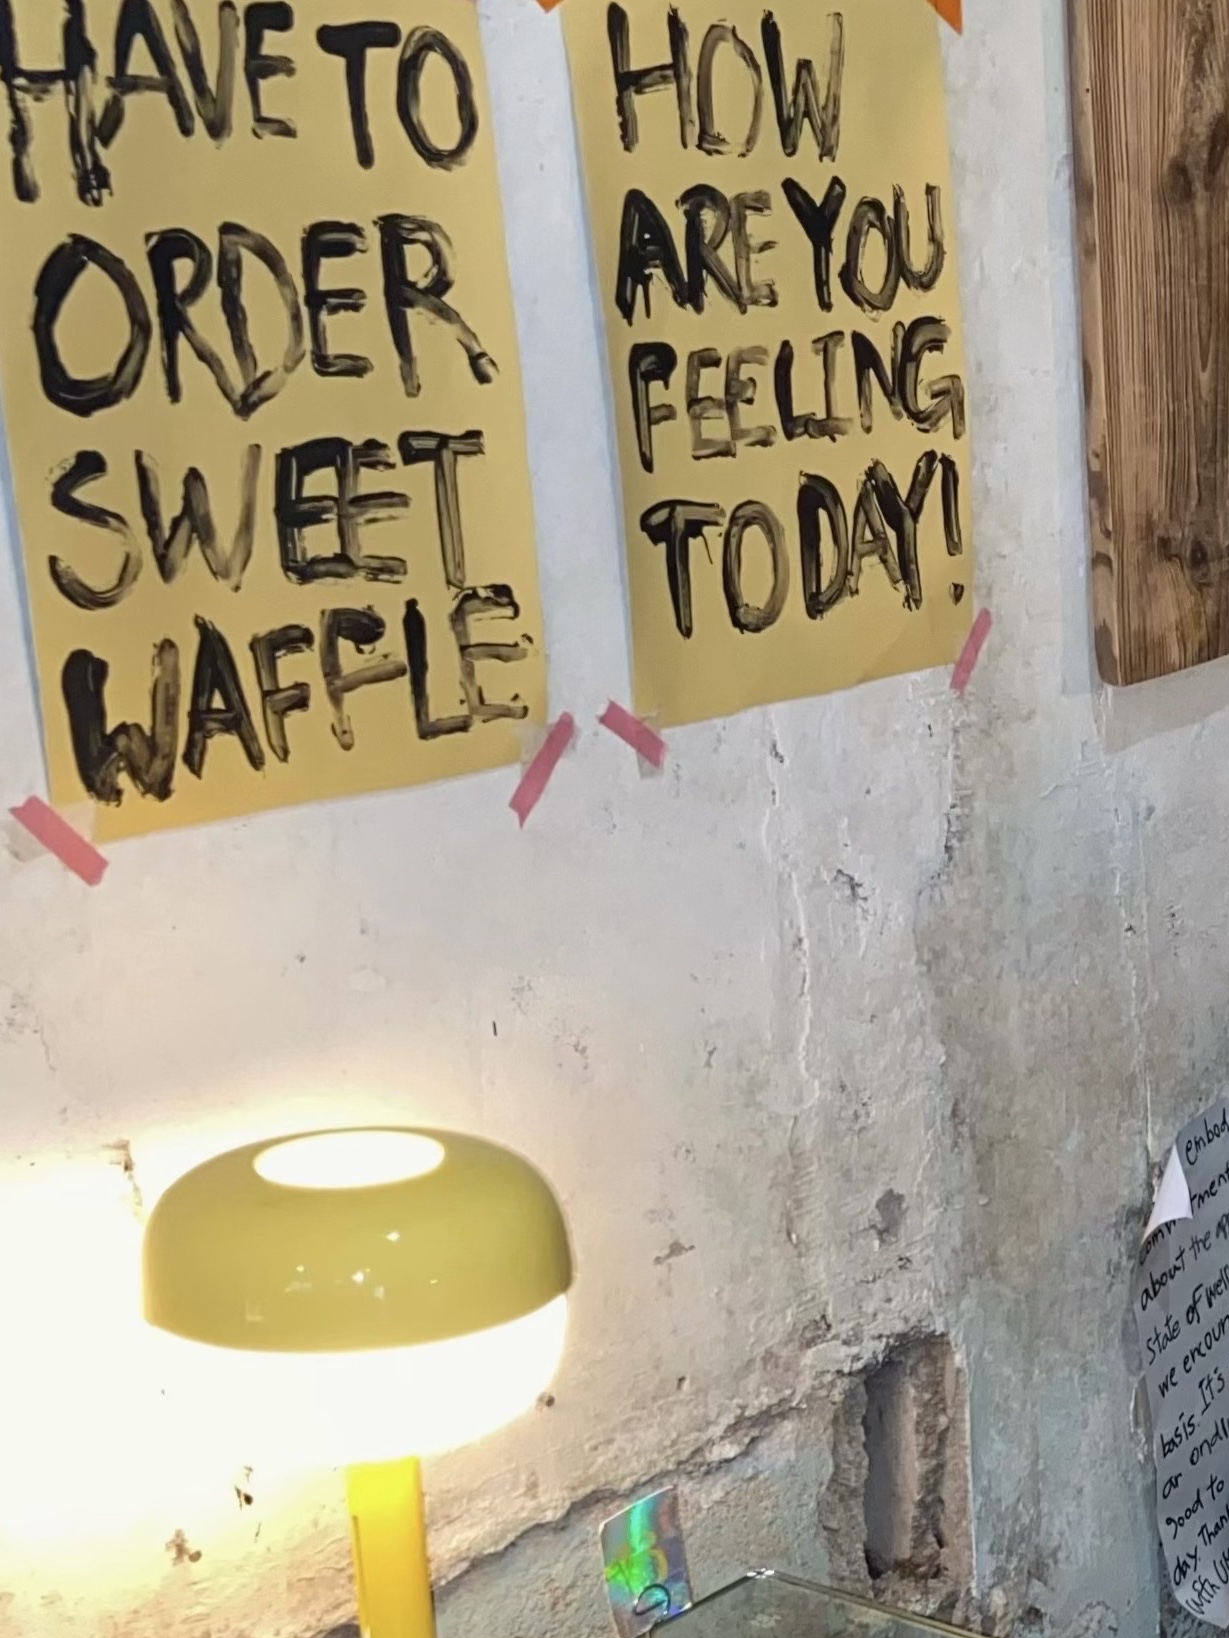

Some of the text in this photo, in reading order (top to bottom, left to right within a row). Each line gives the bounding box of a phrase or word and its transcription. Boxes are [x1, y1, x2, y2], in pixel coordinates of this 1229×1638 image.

[3, 0, 479, 206] HAVE TO
[607, 3, 844, 163] HOW
[32, 214, 499, 420] ORDER
[615, 175, 946, 326] ARE YOU
[628, 316, 966, 473] FEELING
[47, 430, 485, 611] SWEET
[640, 449, 965, 639] TODAY!
[61, 583, 534, 807] WAFFLE
[1141, 1245, 1186, 1311] about
[1189, 1230, 1212, 1261] the
[1186, 1283, 1203, 1325] of
[1158, 1367, 1179, 1398] we
[1165, 1488, 1205, 1540] good
[1206, 1473, 1224, 1501] to
